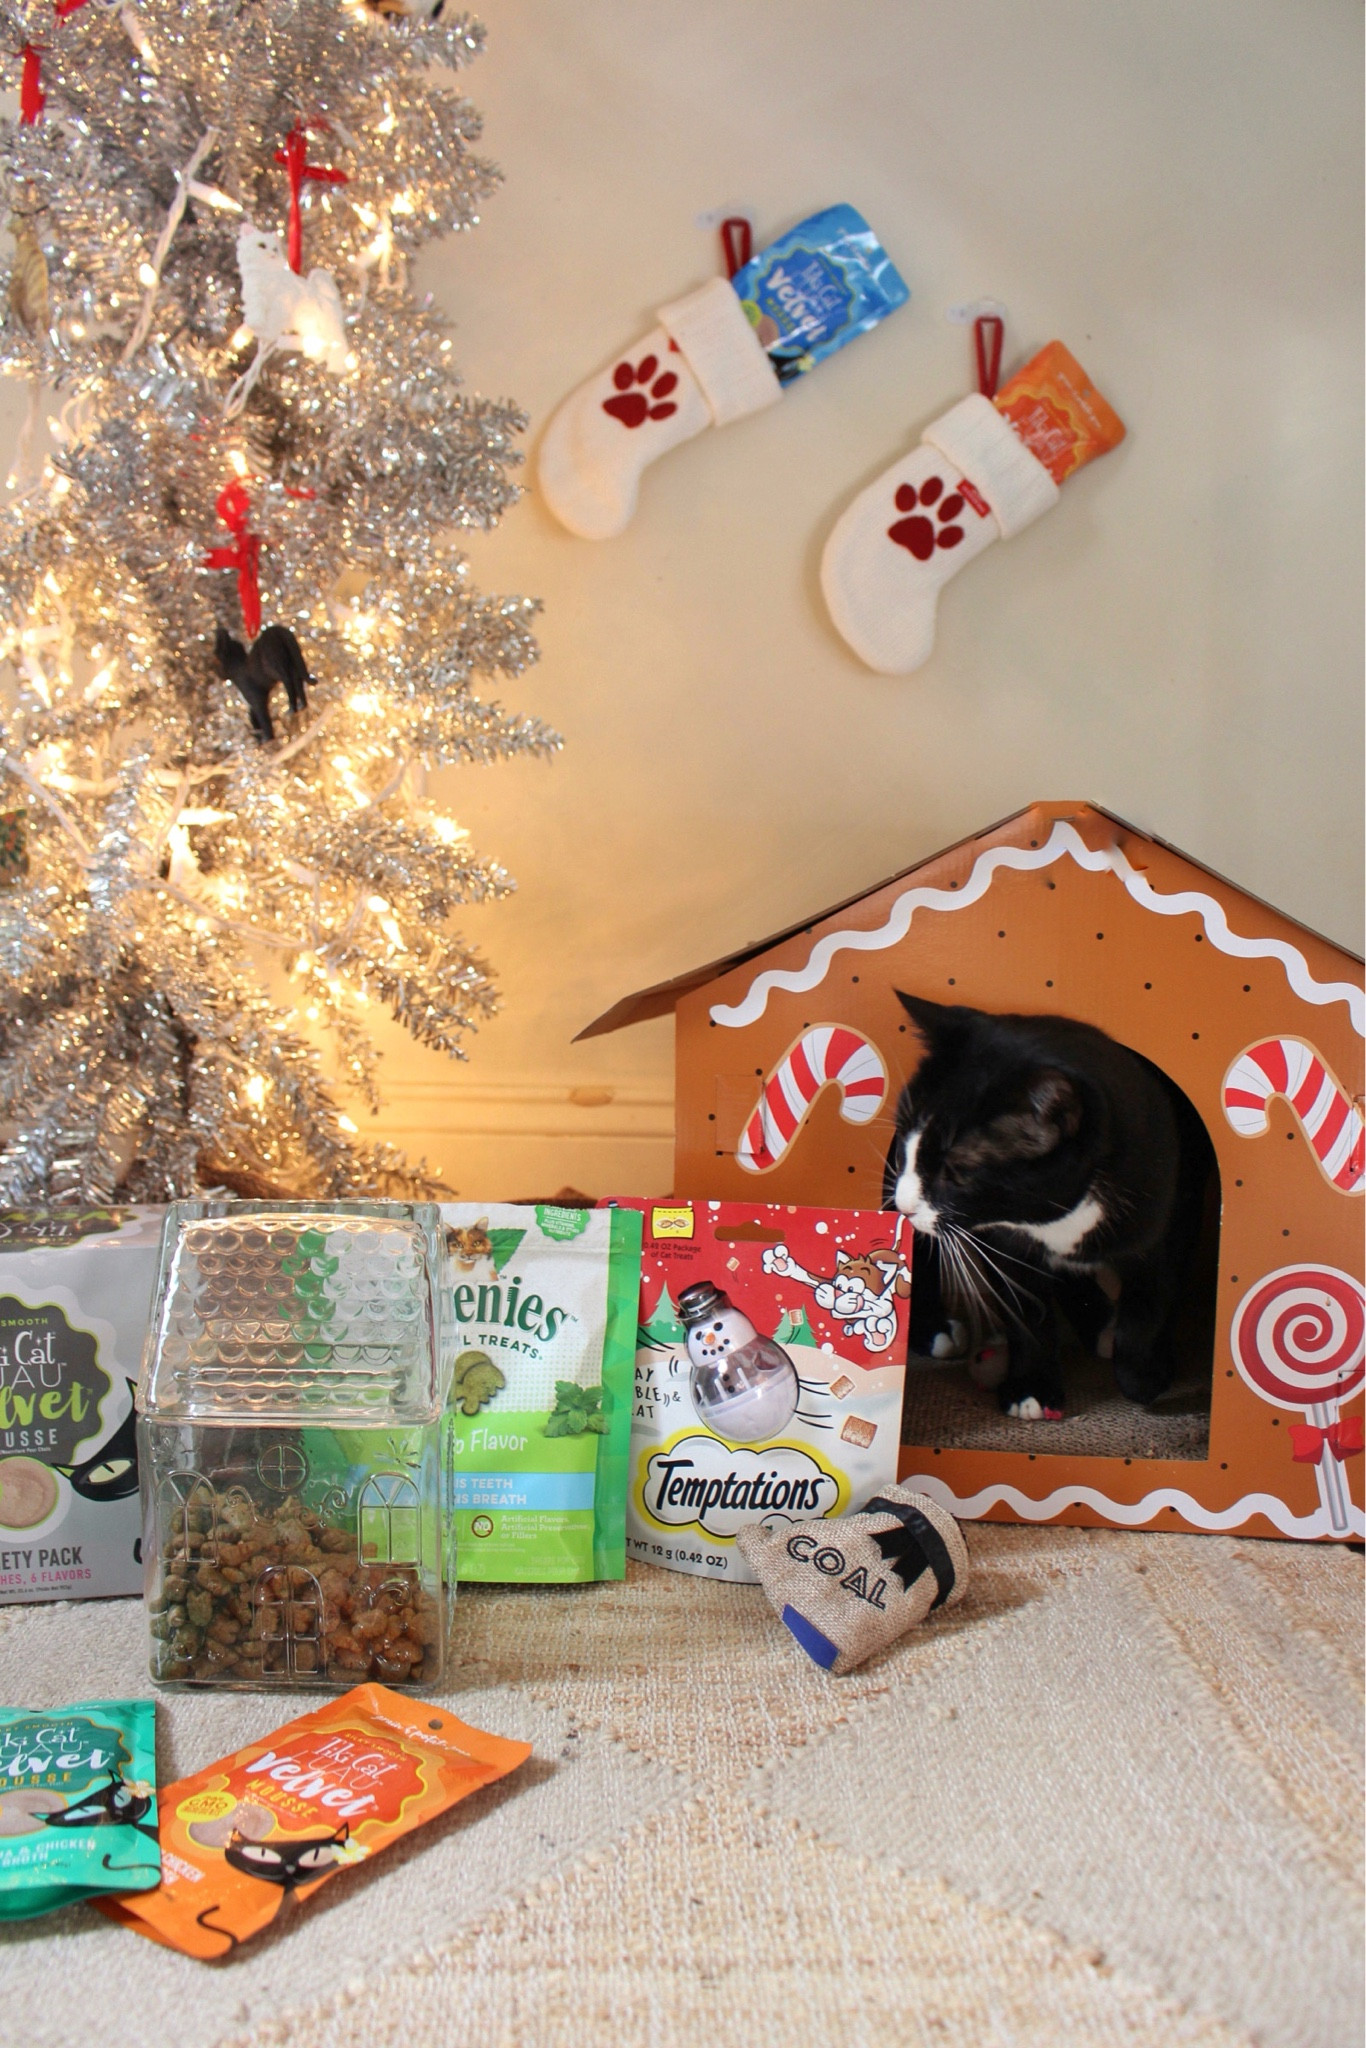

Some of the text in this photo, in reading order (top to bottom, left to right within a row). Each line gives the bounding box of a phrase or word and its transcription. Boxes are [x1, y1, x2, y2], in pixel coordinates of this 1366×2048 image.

[543, 1207, 582, 1221] INGREDIENTS
[673, 1244, 702, 1253] Package
[1, 1318, 49, 1327] SMOOTH
[15, 1330, 56, 1366] Cat
[478, 1334, 540, 1359] TREATS
[635, 1386, 661, 1402] BLE
[632, 1405, 654, 1418] AT
[5, 1428, 59, 1448] USSE
[470, 1427, 529, 1453] Flavor
[472, 1478, 513, 1489] TEETH
[656, 1459, 826, 1520] Temptations
[472, 1493, 527, 1505] BREATH
[474, 1520, 490, 1531] NO
[501, 1515, 538, 1523] Artificial
[501, 1523, 538, 1531] Artificial
[511, 1531, 538, 1539] Fillers
[38, 1546, 83, 1568] PACK
[634, 1539, 648, 1552] WT
[651, 1545, 663, 1556] 12
[666, 1549, 672, 1560] g
[675, 1548, 702, 1563] (0.42
[706, 1555, 728, 1570] OZ)
[30, 1573, 37, 1583] 6
[41, 1568, 92, 1582] FLAVORS
[786, 1534, 888, 1611] COAL
[36, 1727, 77, 1744] Cat
[345, 1733, 406, 1762] SILKY SMOOTH
[0, 1749, 110, 1777] lvet
[311, 1736, 398, 1779] Tiki Cat
[246, 1751, 375, 1818] Velvet
[189, 1799, 228, 1810] GMO
[246, 1778, 318, 1818] MOUSSE
